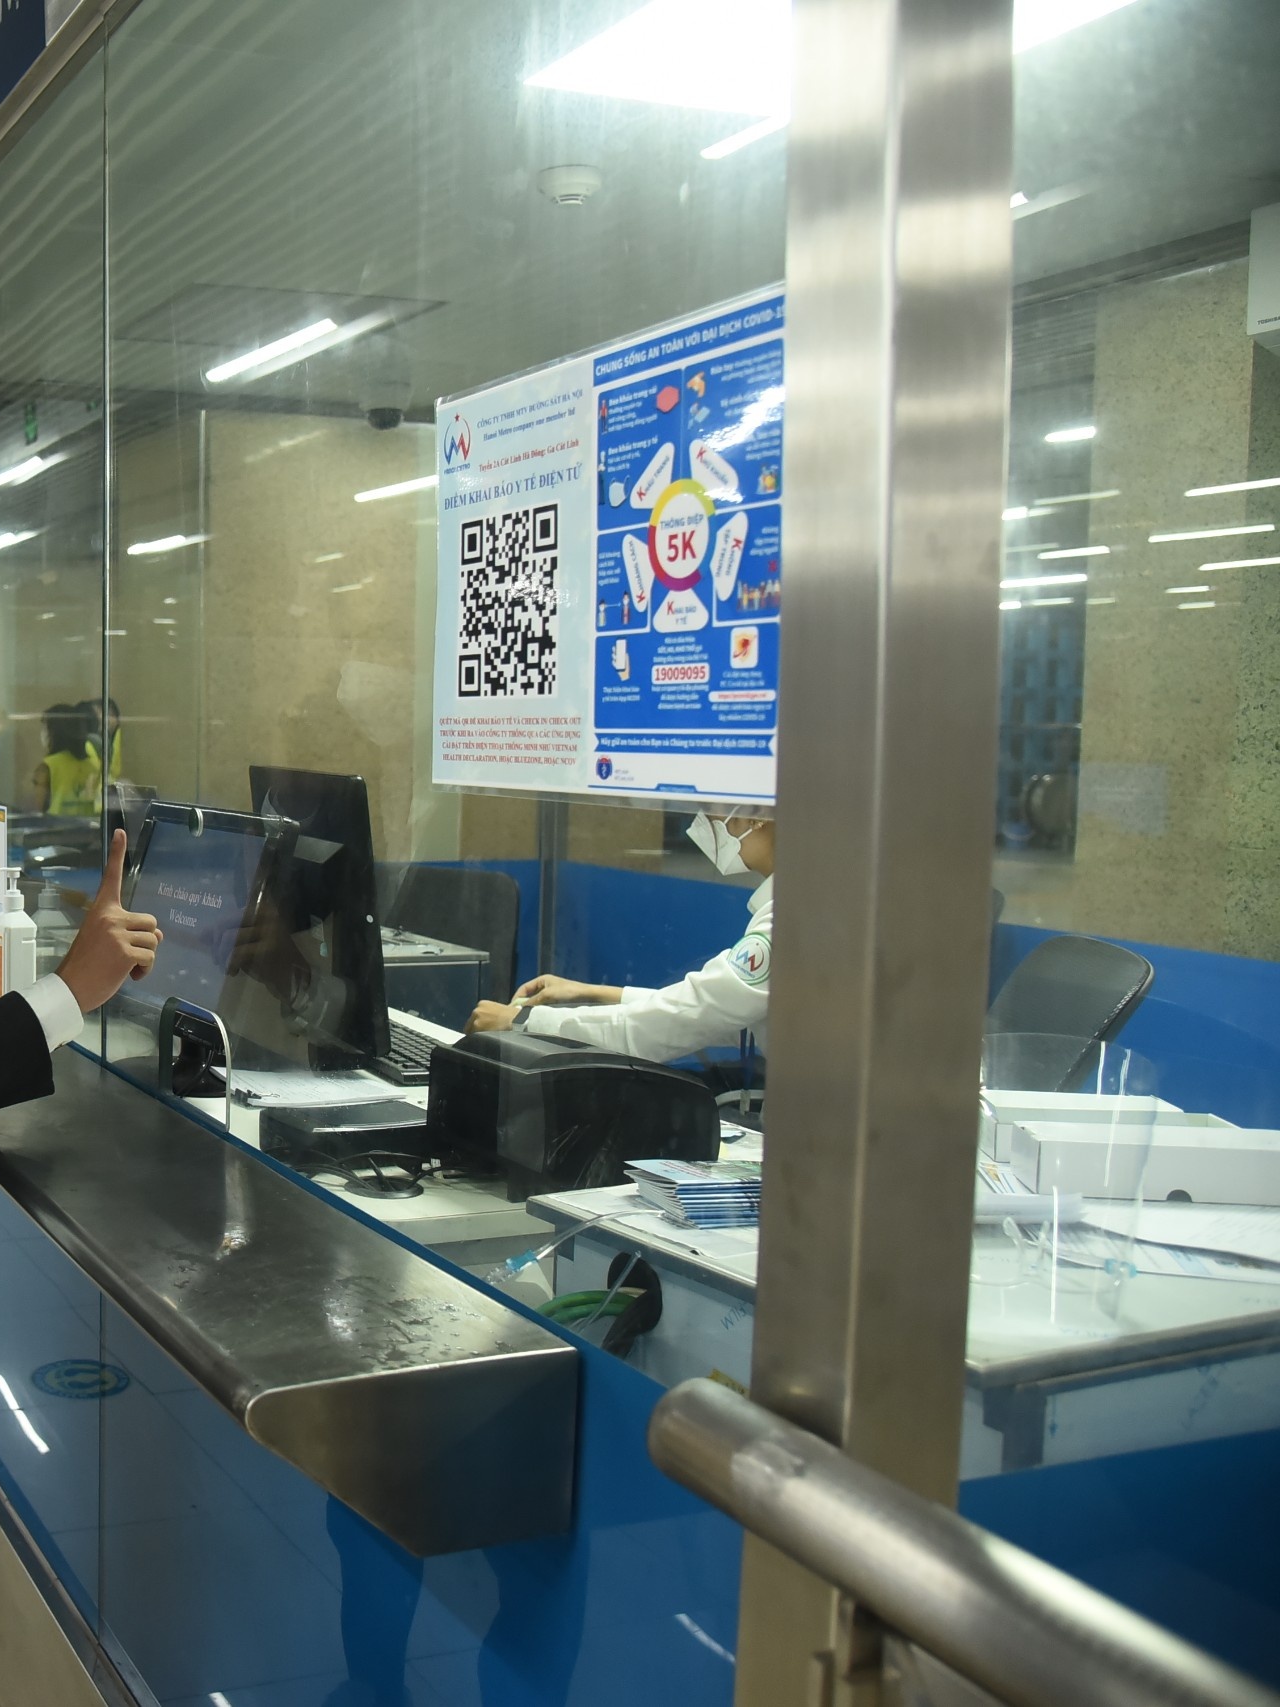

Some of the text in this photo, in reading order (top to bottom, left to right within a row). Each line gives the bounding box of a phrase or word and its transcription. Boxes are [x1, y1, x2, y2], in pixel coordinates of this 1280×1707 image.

[595, 358, 623, 377] CHUNG
[624, 350, 647, 368] SỐNG
[647, 345, 659, 359] AN
[661, 336, 684, 355] TOÀN
[685, 330, 701, 348] VỚI
[719, 319, 742, 339] DỊCH
[500, 411, 515, 422] TNHH
[444, 461, 582, 510] ĐIỂM KHAI BÁO Y TẾ ĐIỆN TỬ
[660, 513, 704, 530] THÔNG ĐIỆP
[667, 530, 697, 562] 5K
[654, 665, 706, 681] 19009095
[158, 882, 173, 898] Kính
[173, 888, 188, 901] chào
[202, 892, 223, 909] khách
[169, 908, 198, 928] Welcome
